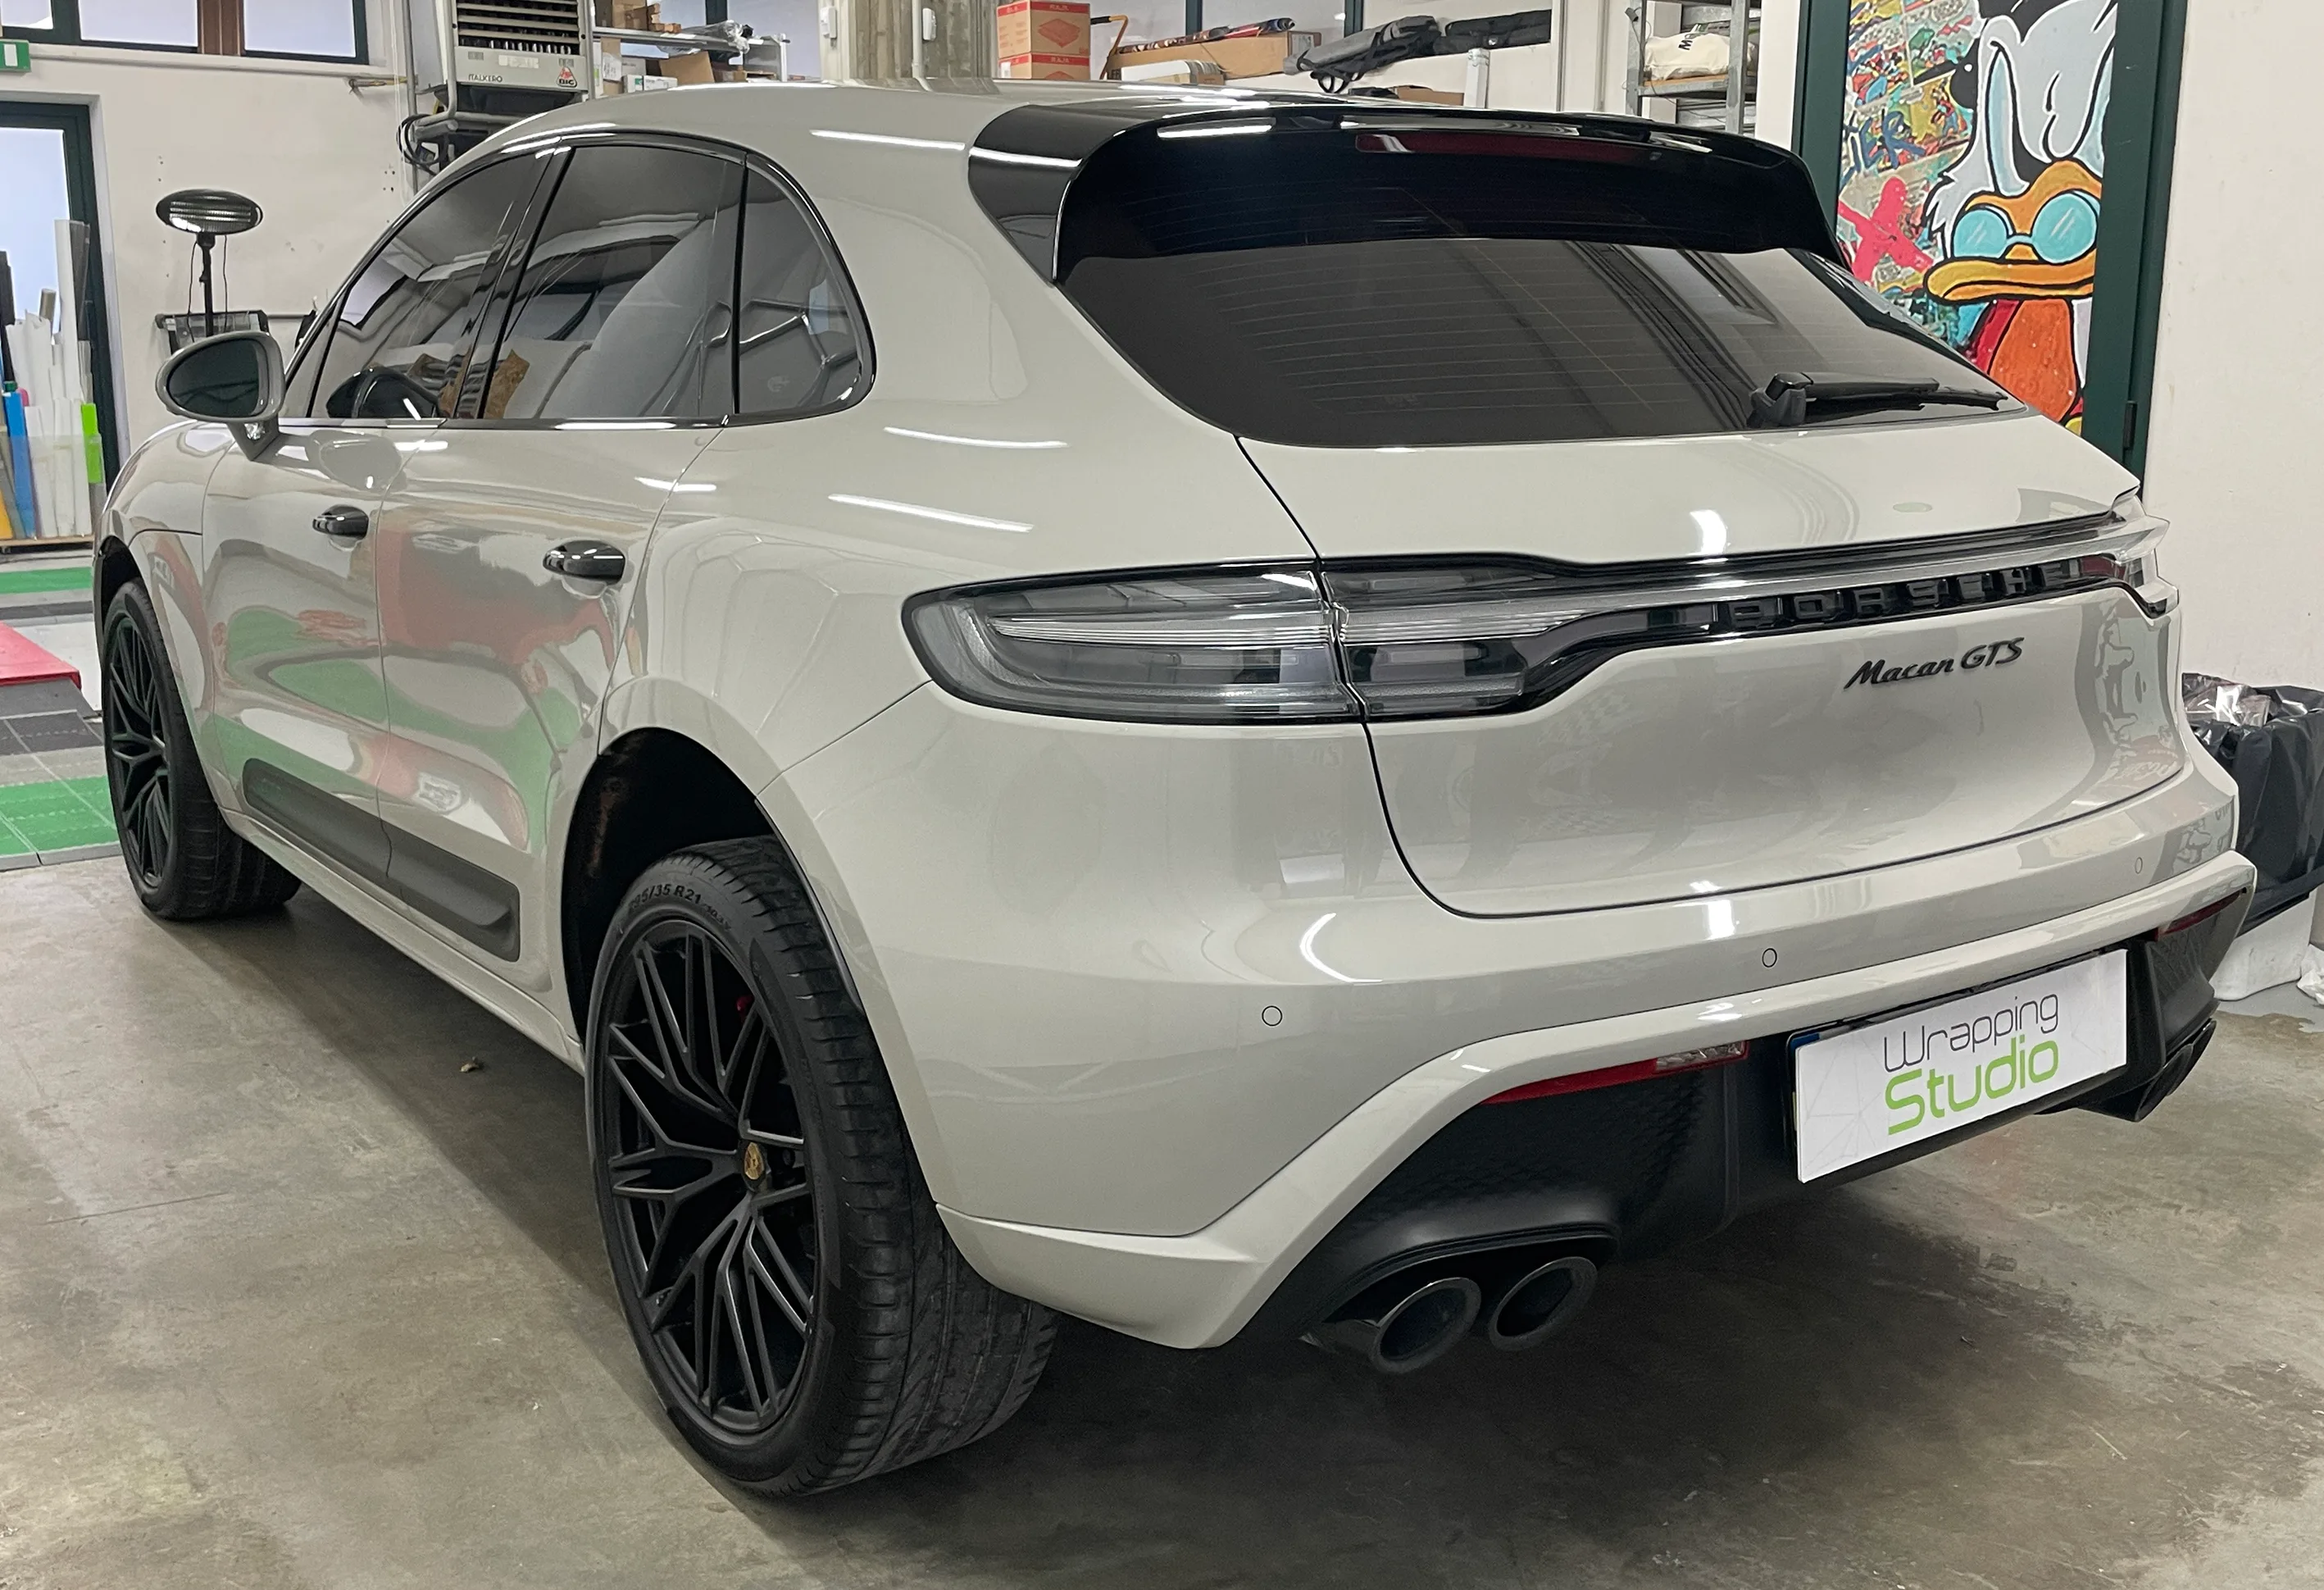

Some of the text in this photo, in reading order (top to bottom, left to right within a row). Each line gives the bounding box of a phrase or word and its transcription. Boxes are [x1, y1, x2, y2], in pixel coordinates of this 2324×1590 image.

[1729, 561, 2071, 627] PORSCHE
[1844, 636, 2024, 690] Macan GTS
[1884, 994, 2058, 1072] Wrapping
[1885, 1034, 2059, 1136] Studio
